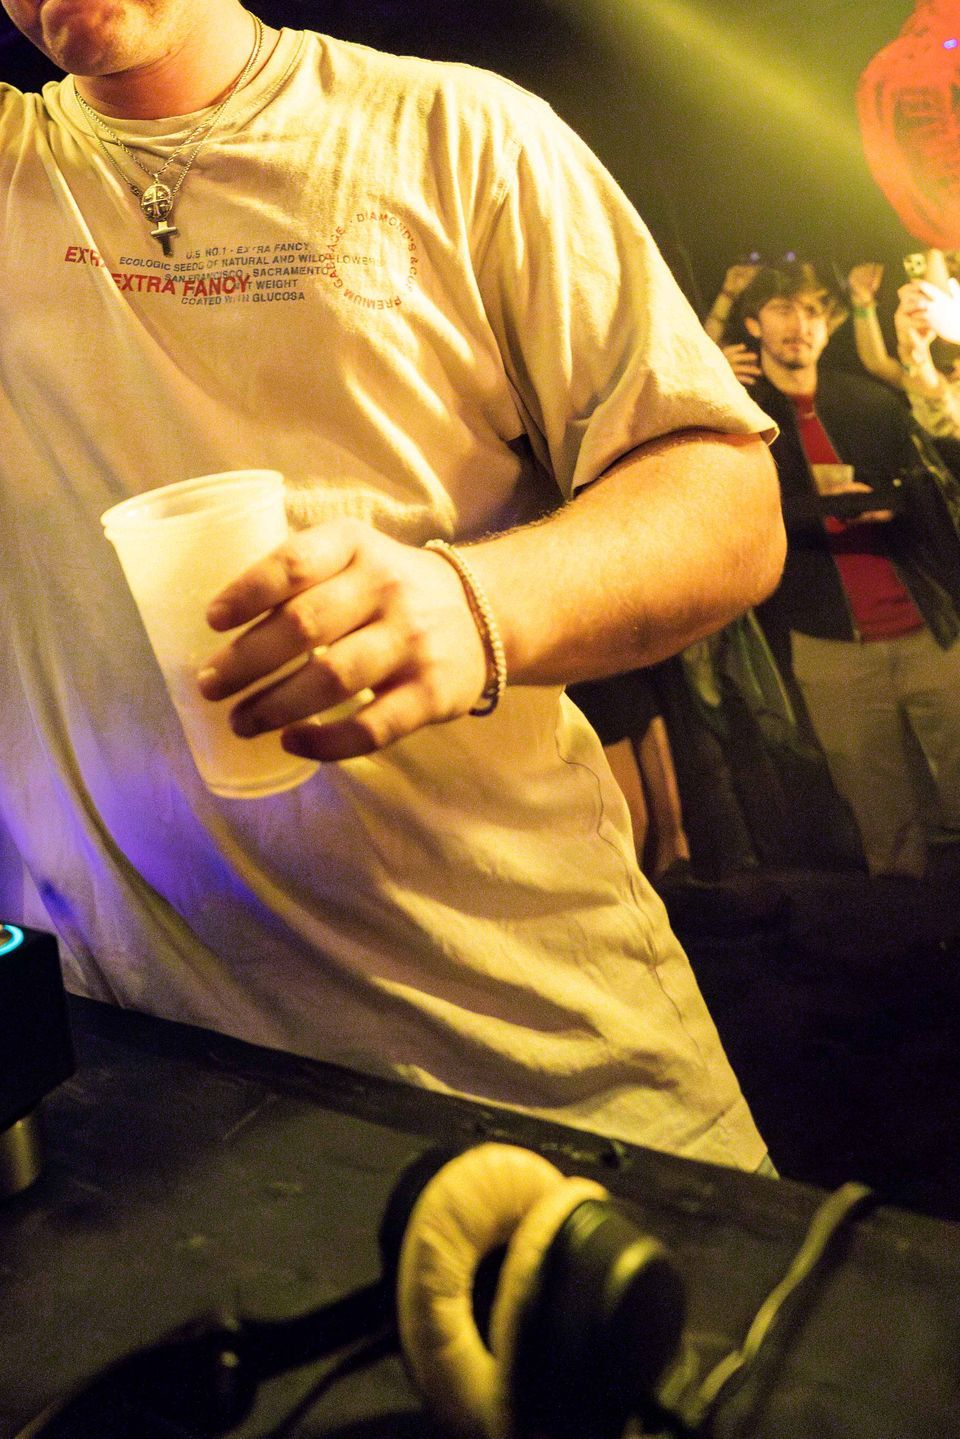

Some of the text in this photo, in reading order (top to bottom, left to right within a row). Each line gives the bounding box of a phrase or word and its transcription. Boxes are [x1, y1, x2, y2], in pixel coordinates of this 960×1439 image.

[236, 244, 271, 254] EXRA
[273, 241, 310, 253] FANCY
[119, 256, 171, 271] ECOLOGIC
[222, 257, 270, 267] NATURAL
[272, 253, 295, 264] AND
[253, 266, 330, 278] SACRAMENTO
[111, 273, 251, 298] EXTRA FANCY
[256, 278, 300, 291] WEIGHT
[181, 296, 222, 306] COATED
